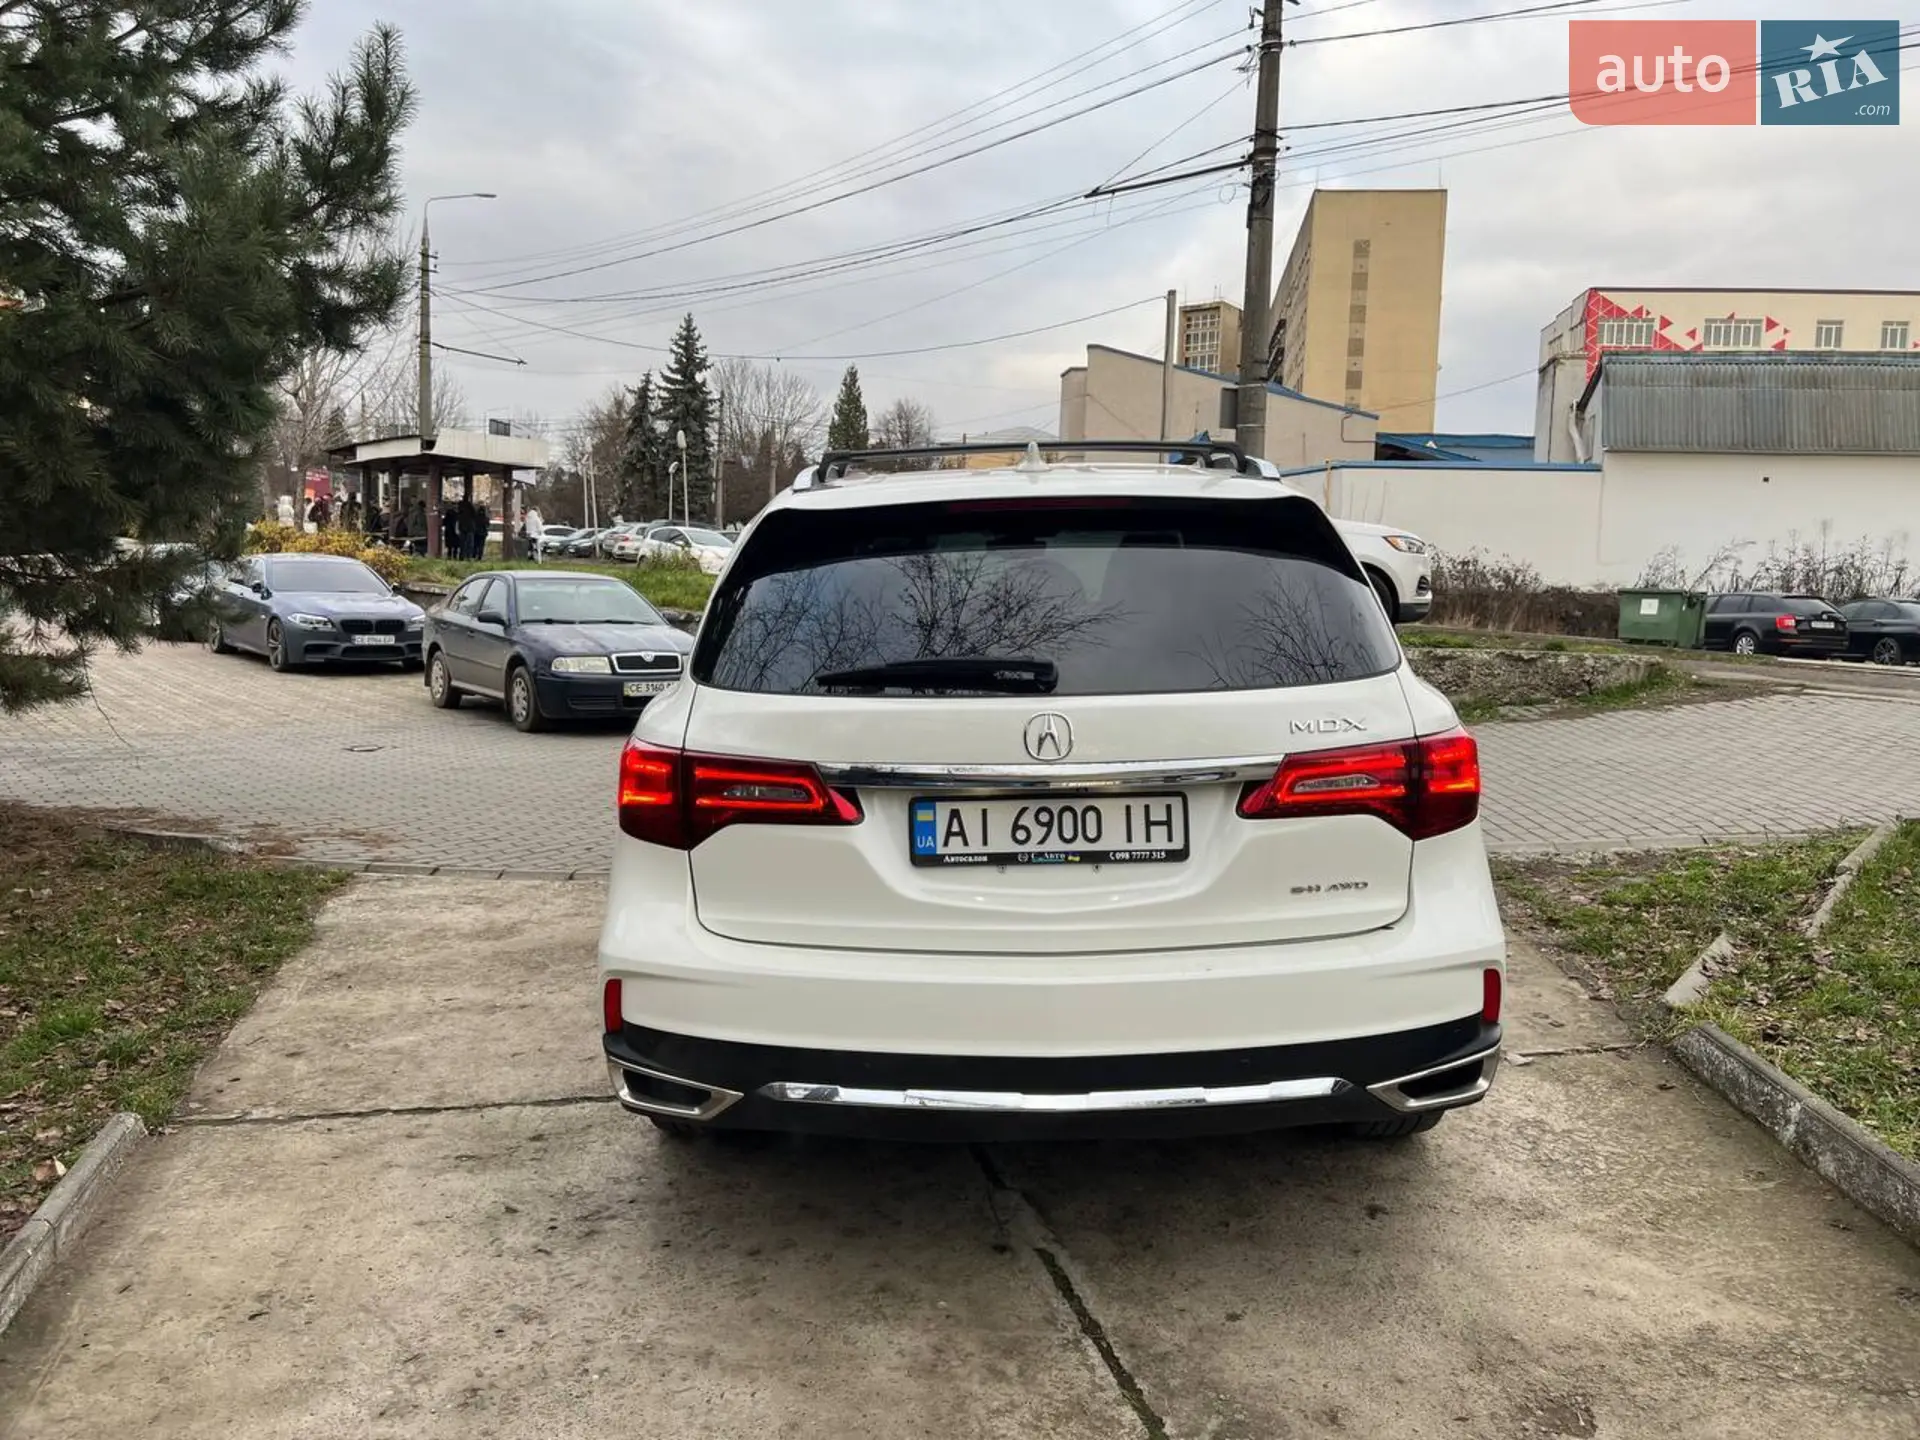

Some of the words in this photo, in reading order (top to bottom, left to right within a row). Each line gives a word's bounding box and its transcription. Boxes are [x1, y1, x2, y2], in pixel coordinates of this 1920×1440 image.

[630, 683, 643, 693] CE
[1290, 718, 1368, 734] MDX
[943, 808, 988, 847] AI
[1011, 804, 1103, 846] 6900
[1125, 803, 1174, 843] IH
[916, 836, 935, 849] UA
[1131, 851, 1150, 860] 7777
